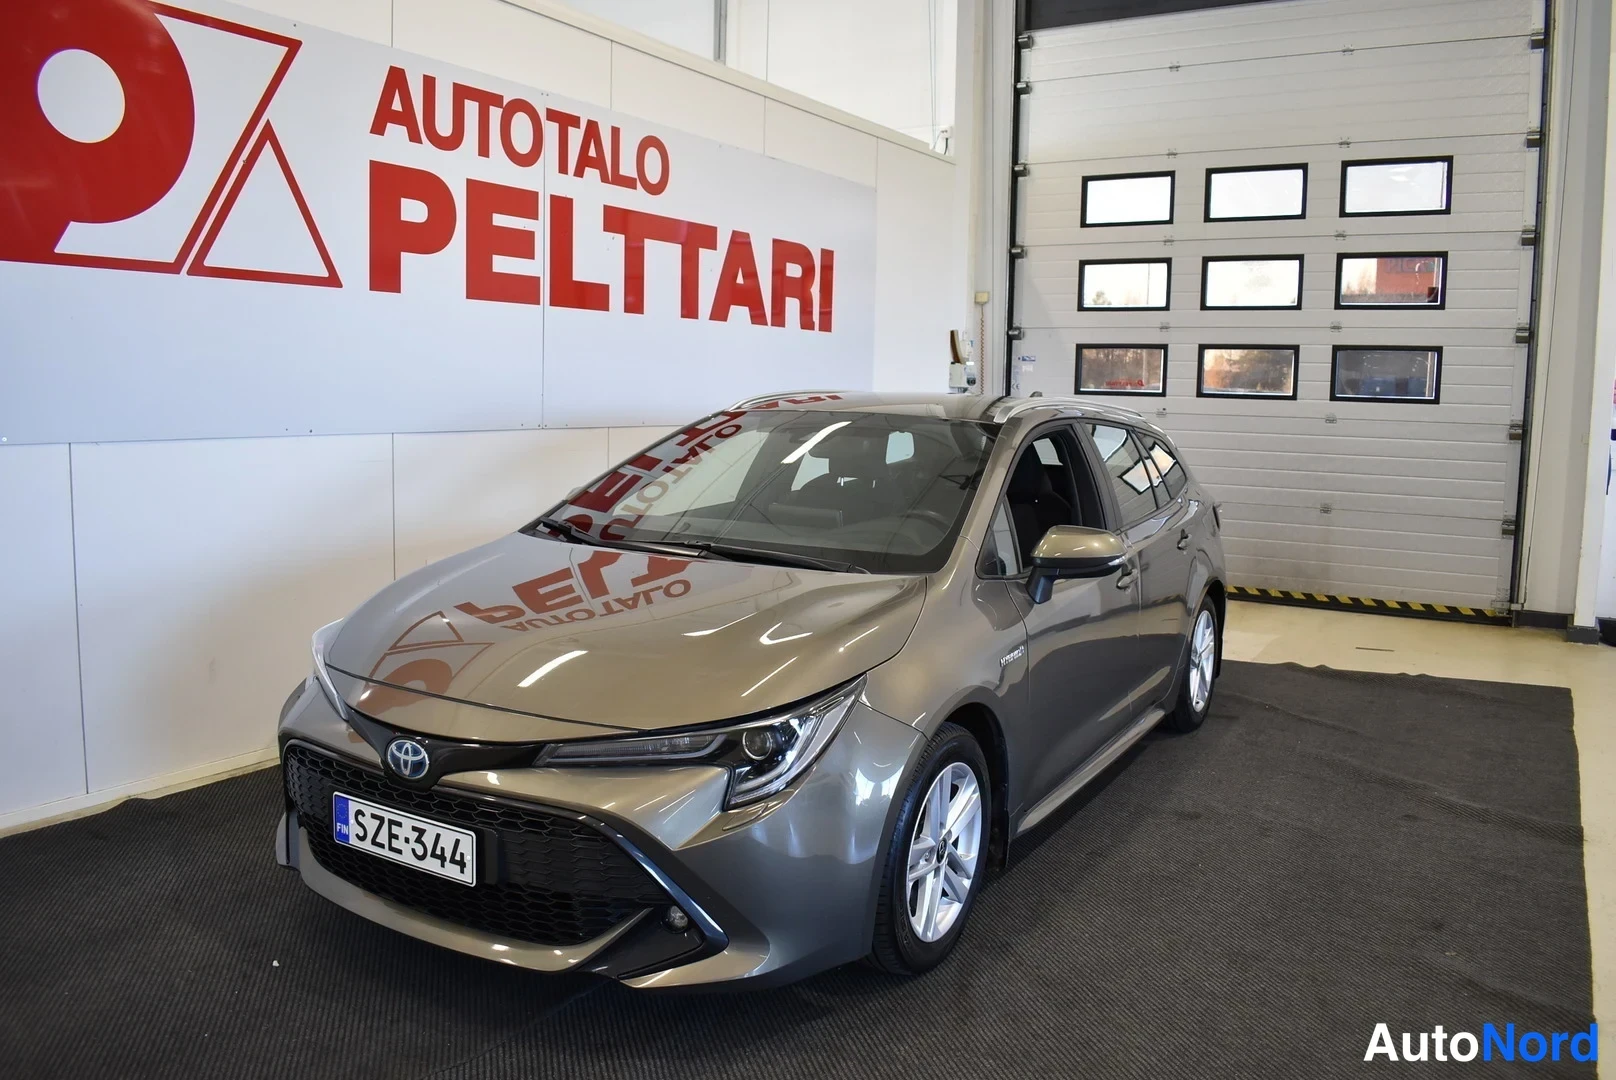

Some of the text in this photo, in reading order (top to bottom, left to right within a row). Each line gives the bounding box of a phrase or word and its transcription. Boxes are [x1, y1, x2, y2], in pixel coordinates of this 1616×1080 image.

[370, 65, 670, 196] AUTOTALO
[369, 160, 834, 332] PELTTARI
[336, 808, 467, 875] FIN SZE-344
